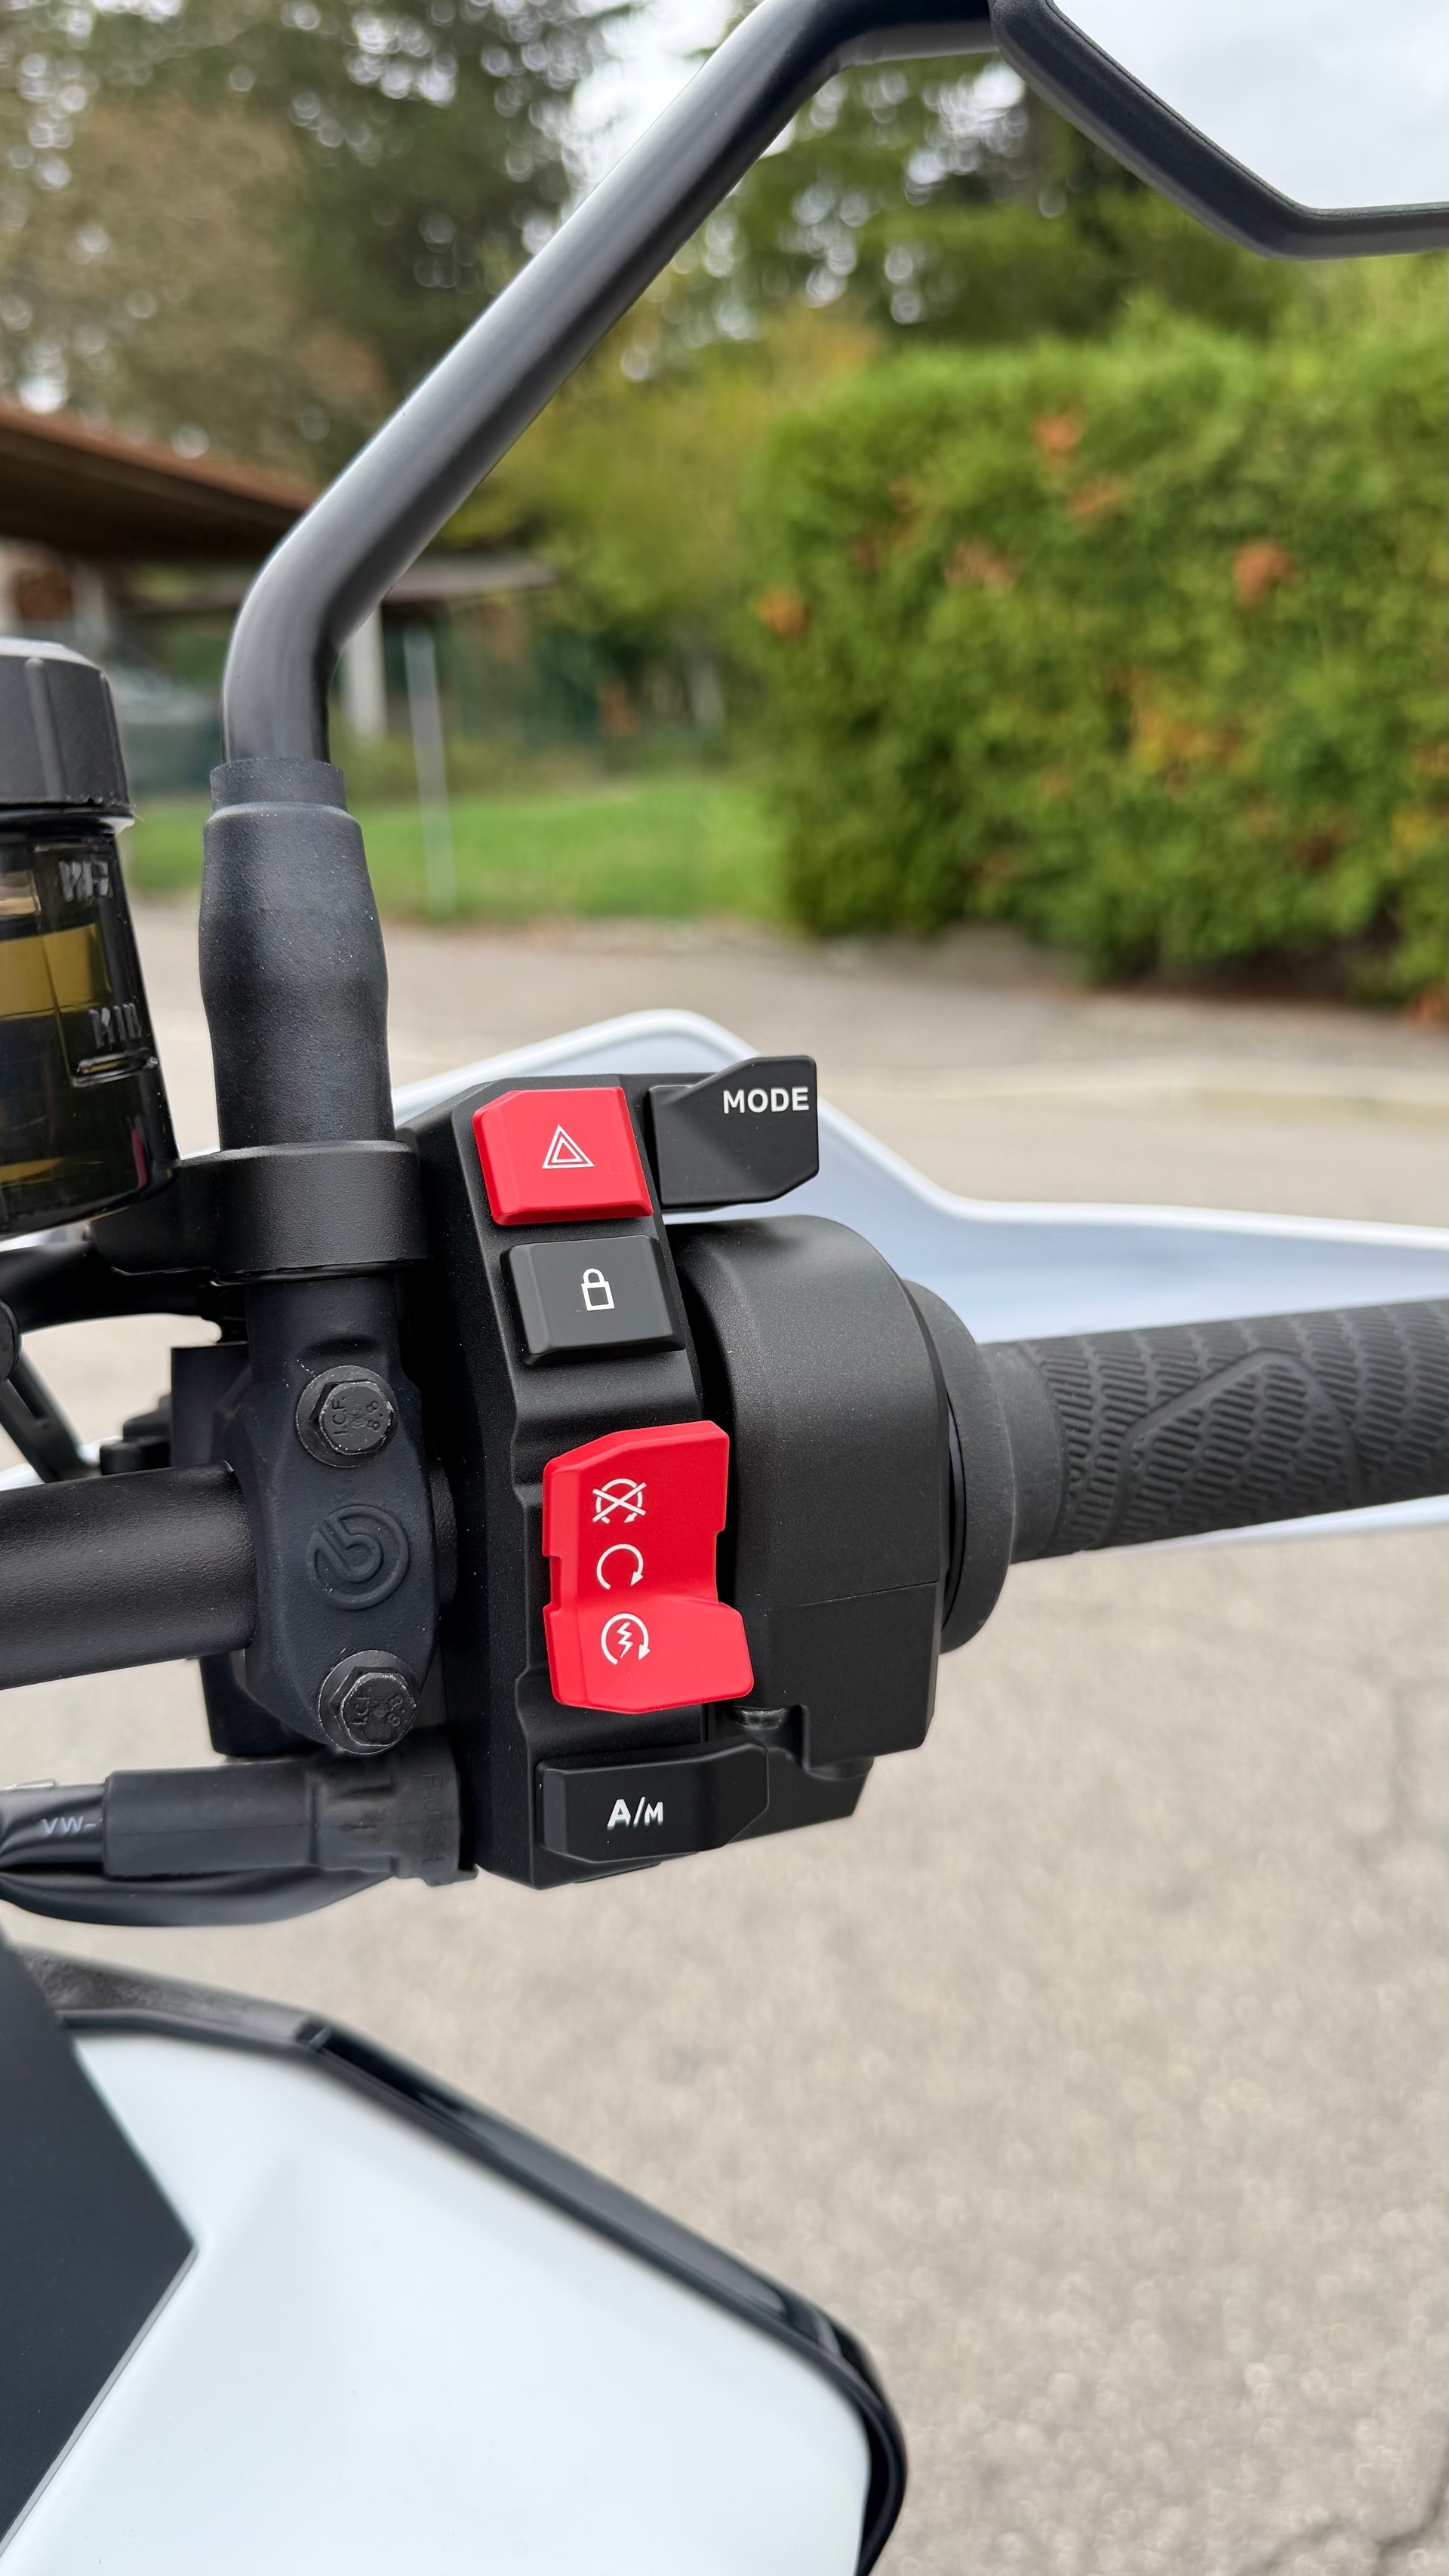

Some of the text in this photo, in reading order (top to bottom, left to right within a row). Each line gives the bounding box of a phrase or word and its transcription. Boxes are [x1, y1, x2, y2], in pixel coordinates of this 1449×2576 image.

[722, 1086, 810, 1114] MODE
[42, 1815, 103, 1836] VW-
[422, 1773, 447, 1862] PUSH
[607, 1796, 663, 1830] A/M
